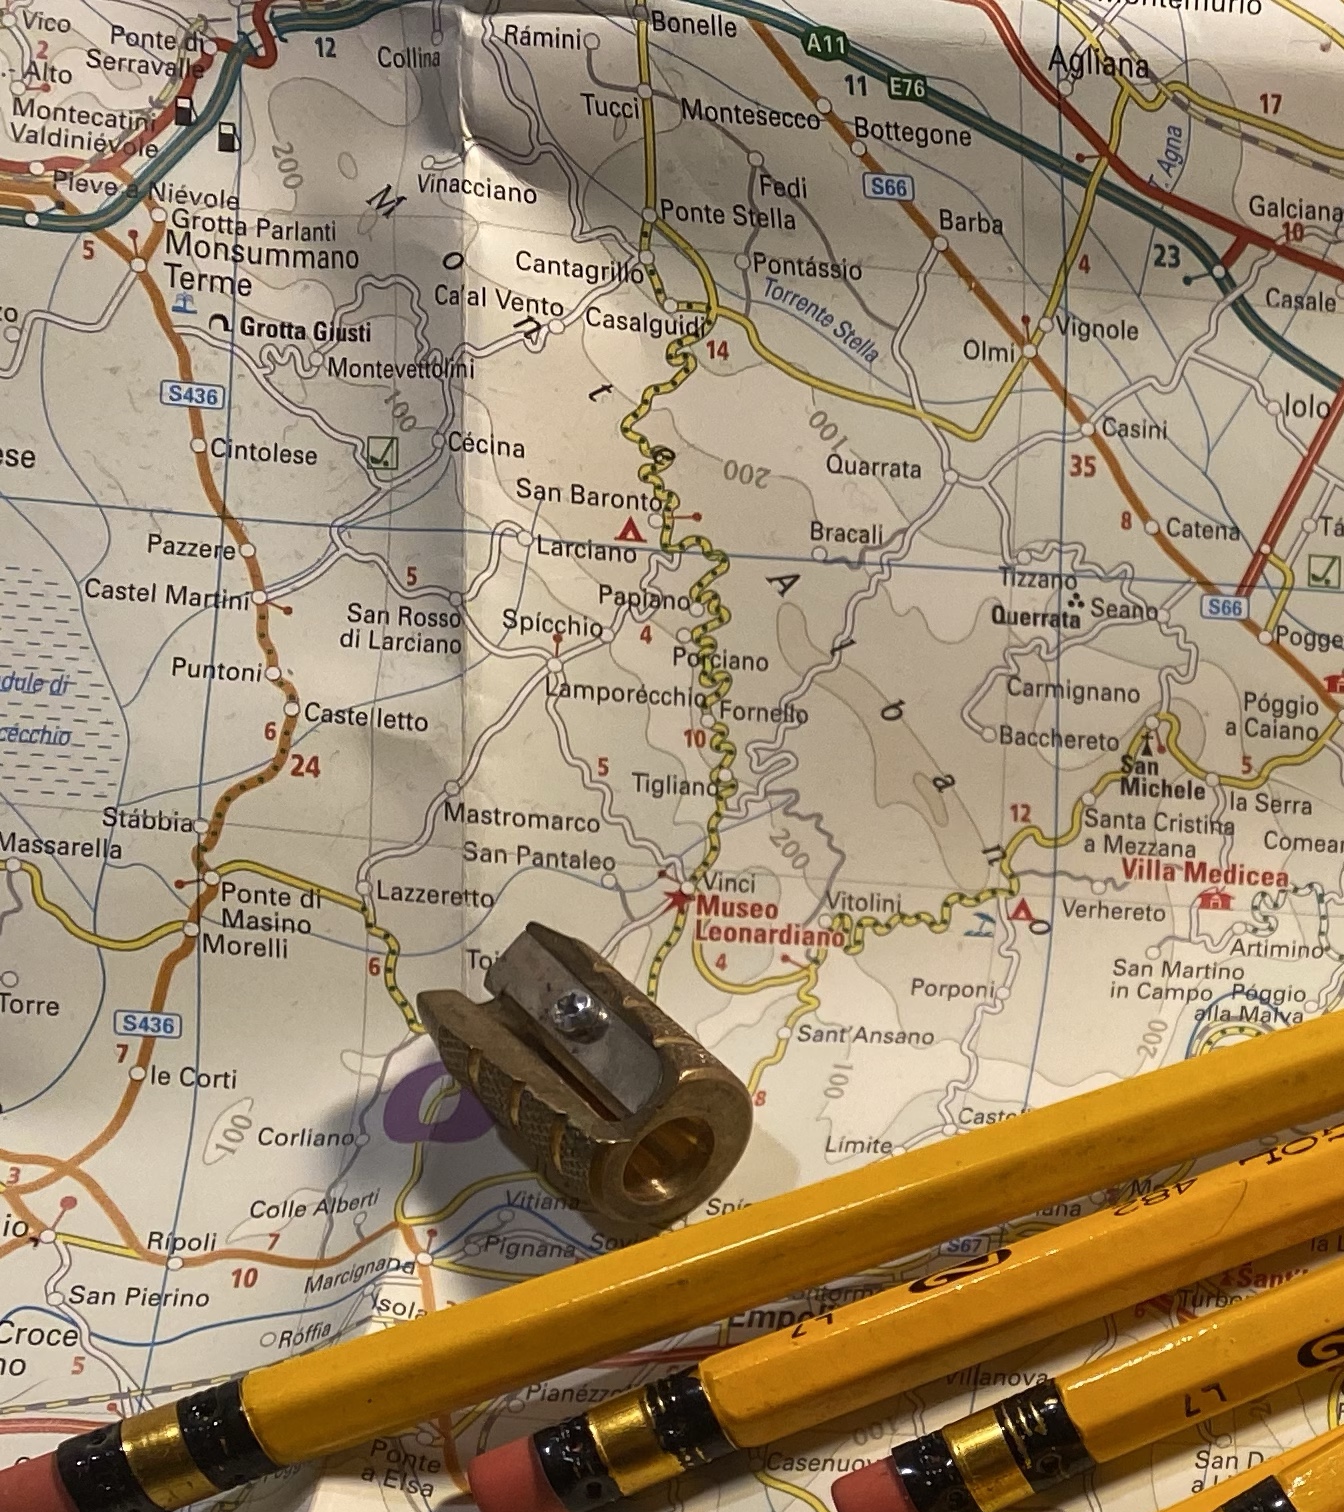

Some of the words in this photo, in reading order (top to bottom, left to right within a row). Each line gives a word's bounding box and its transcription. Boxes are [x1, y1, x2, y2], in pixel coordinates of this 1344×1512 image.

[652, 11, 738, 38] Bonelle
[806, 32, 846, 55] A11
[1049, 47, 1150, 82] Agliana
[854, 116, 971, 149] Bottegone
[418, 174, 538, 205] Vinacciano
[871, 178, 908, 196] S66
[1249, 196, 1344, 222] Galciana
[166, 230, 359, 270] Monsummano
[516, 251, 644, 285] Cantagrillo
[753, 251, 862, 281] Pontássio
[166, 265, 252, 296] Terme
[241, 316, 304, 342] Grotta
[311, 319, 371, 344] Giusti
[169, 386, 218, 406] S436
[211, 439, 318, 466] Cintolese
[826, 455, 922, 482] Quarrata
[172, 658, 262, 682] Puntoni
[1008, 678, 1141, 704] Carmignano
[304, 702, 428, 732] Castelletto
[1000, 726, 1119, 753] Bacchereto
[291, 755, 320, 778] 24
[444, 801, 600, 834] Mastromarco
[1122, 858, 1178, 882] Villa
[1184, 864, 1289, 888] Medicea
[377, 881, 494, 909] Lazzeretto
[700, 896, 778, 920] Museo
[700, 921, 845, 948] Leonardiano
[121, 1015, 175, 1034] S436
[258, 1126, 355, 1149] Corliano
